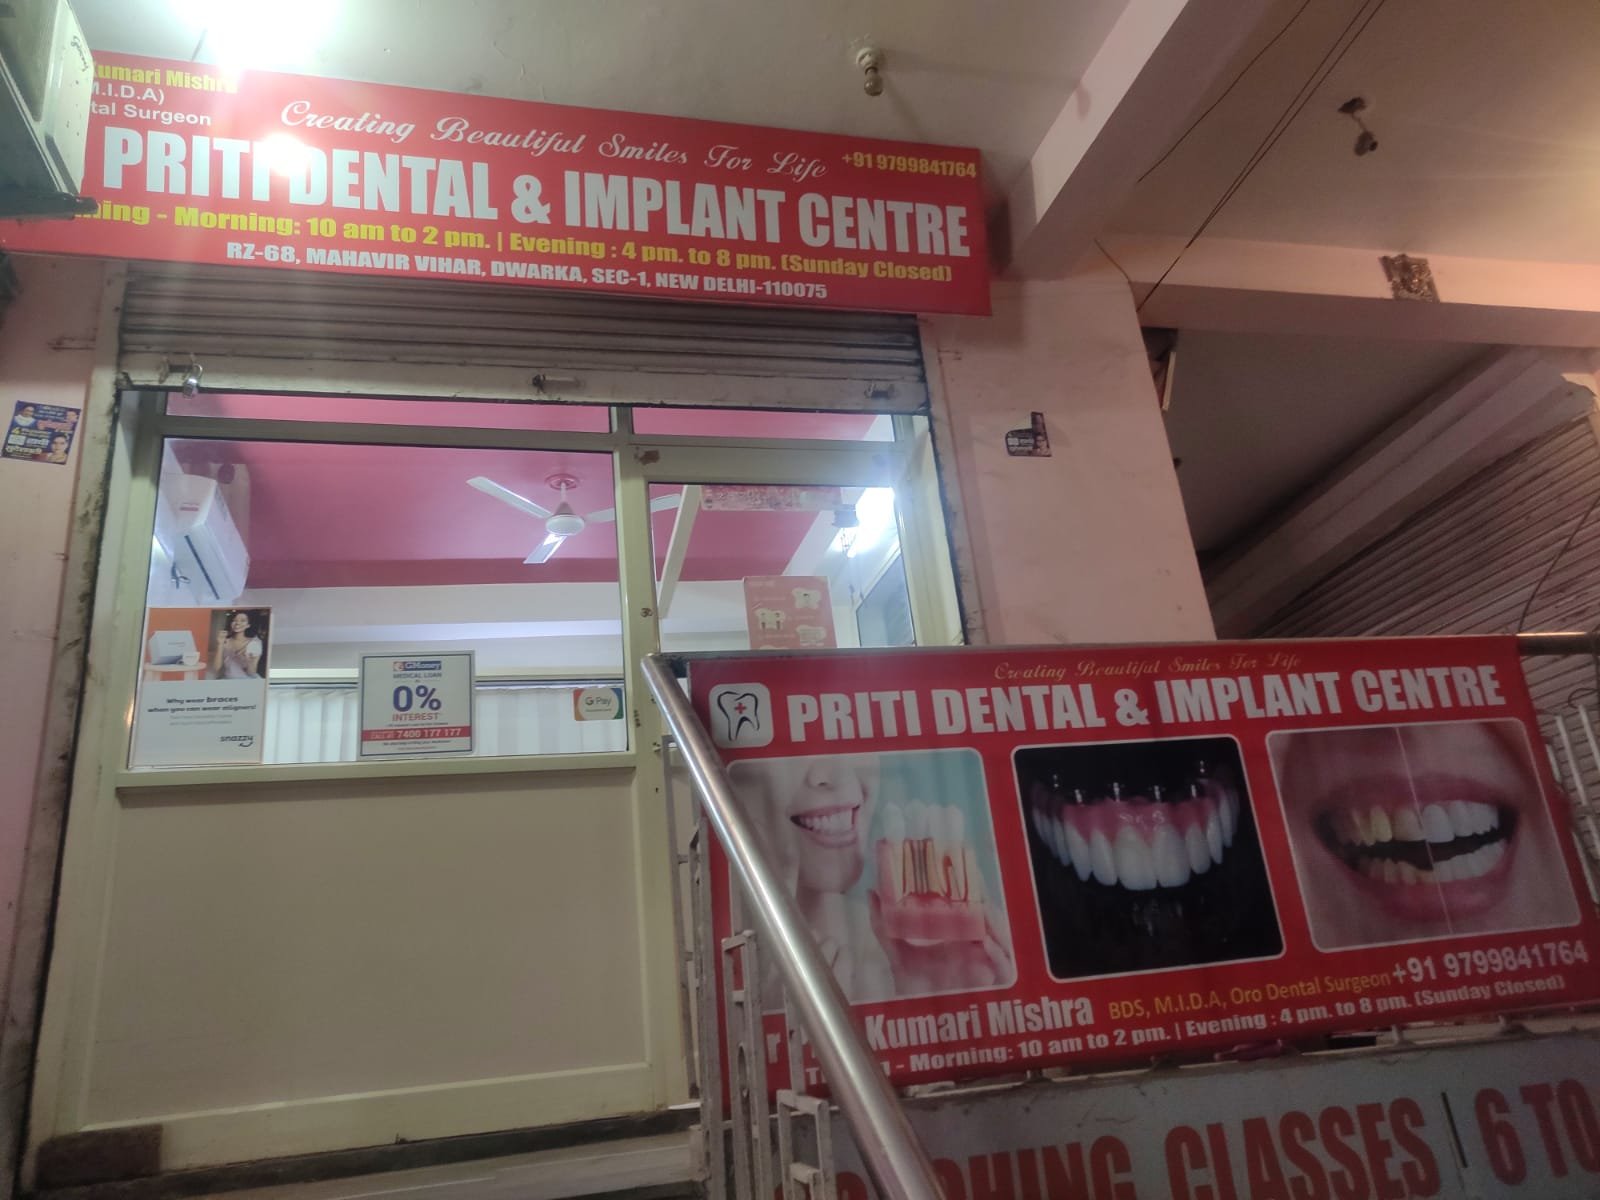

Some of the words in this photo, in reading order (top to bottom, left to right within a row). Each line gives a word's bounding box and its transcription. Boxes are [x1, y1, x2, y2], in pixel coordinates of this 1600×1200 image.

[94, 63, 161, 86] umari
[166, 69, 239, 94] Mishra
[123, 104, 212, 126] Surgeon
[280, 100, 415, 142] Creating
[435, 117, 584, 157] Beautiful
[598, 133, 689, 165] Smiles
[703, 145, 752, 172] For
[766, 152, 829, 183] Life
[104, 126, 270, 202] PRITI
[286, 143, 498, 221] DENTAL
[511, 174, 551, 225] &
[564, 170, 786, 243] IMPLANT
[797, 193, 971, 257] CENTRE
[842, 150, 876, 169] +91
[876, 153, 977, 178] 9799841764
[174, 206, 301, 236] Morning:
[306, 217, 337, 237] 10
[343, 223, 385, 241] am
[390, 224, 417, 243] to
[422, 226, 439, 245] 2
[444, 229, 490, 248] pm.
[509, 232, 606, 260] Evening
[621, 242, 637, 262] 4
[641, 245, 684, 265] pm.
[688, 247, 711, 266] to
[716, 249, 731, 268] 8
[736, 252, 777, 272] pm.
[781, 254, 869, 279] (Sunday
[873, 260, 953, 283] Closed)
[226, 242, 301, 265] RZ-68,
[306, 248, 410, 271] MAHAVIR
[414, 255, 487, 277] VIHAR,
[491, 260, 588, 285] DWARKA,
[591, 268, 652, 290] SEC-1,
[655, 271, 699, 291] NEW
[703, 276, 828, 299] DELHI-110075
[392, 684, 442, 713] 0%
[994, 662, 1066, 682] Creating
[1076, 659, 1161, 678] Beautiful
[1168, 655, 1221, 672] Smiles
[787, 690, 922, 742] PRITI
[931, 683, 1106, 735] DENTAL
[1113, 688, 1149, 727] &
[1154, 672, 1341, 725] IMPLANT
[1351, 664, 1506, 712] CENTRE
[1108, 1001, 1151, 1020] BDS,
[1230, 986, 1263, 1005] Oro
[1267, 979, 1322, 1000] Dental
[1325, 972, 1392, 995] Surgeon
[1393, 956, 1437, 985] +91
[1443, 940, 1589, 980] 9799841764
[864, 1005, 981, 1052] Kumari
[987, 995, 1096, 1035] Mishra
[909, 1044, 1014, 1073] Morning:
[1018, 1039, 1043, 1059] 10
[1048, 1036, 1083, 1054] am
[1086, 1031, 1110, 1050] to
[1113, 1028, 1130, 1047] 2
[1131, 1023, 1172, 1047] pm.
[1185, 1010, 1268, 1038] Evening
[1279, 1005, 1294, 1025] 4
[1295, 1003, 1334, 1026] pm.
[1335, 999, 1356, 1018] to
[1359, 996, 1374, 1014] 8
[1413, 983, 1493, 1008] (Sunday
[1494, 972, 1566, 998] Closed)
[1474, 1088, 1526, 1186] 6
